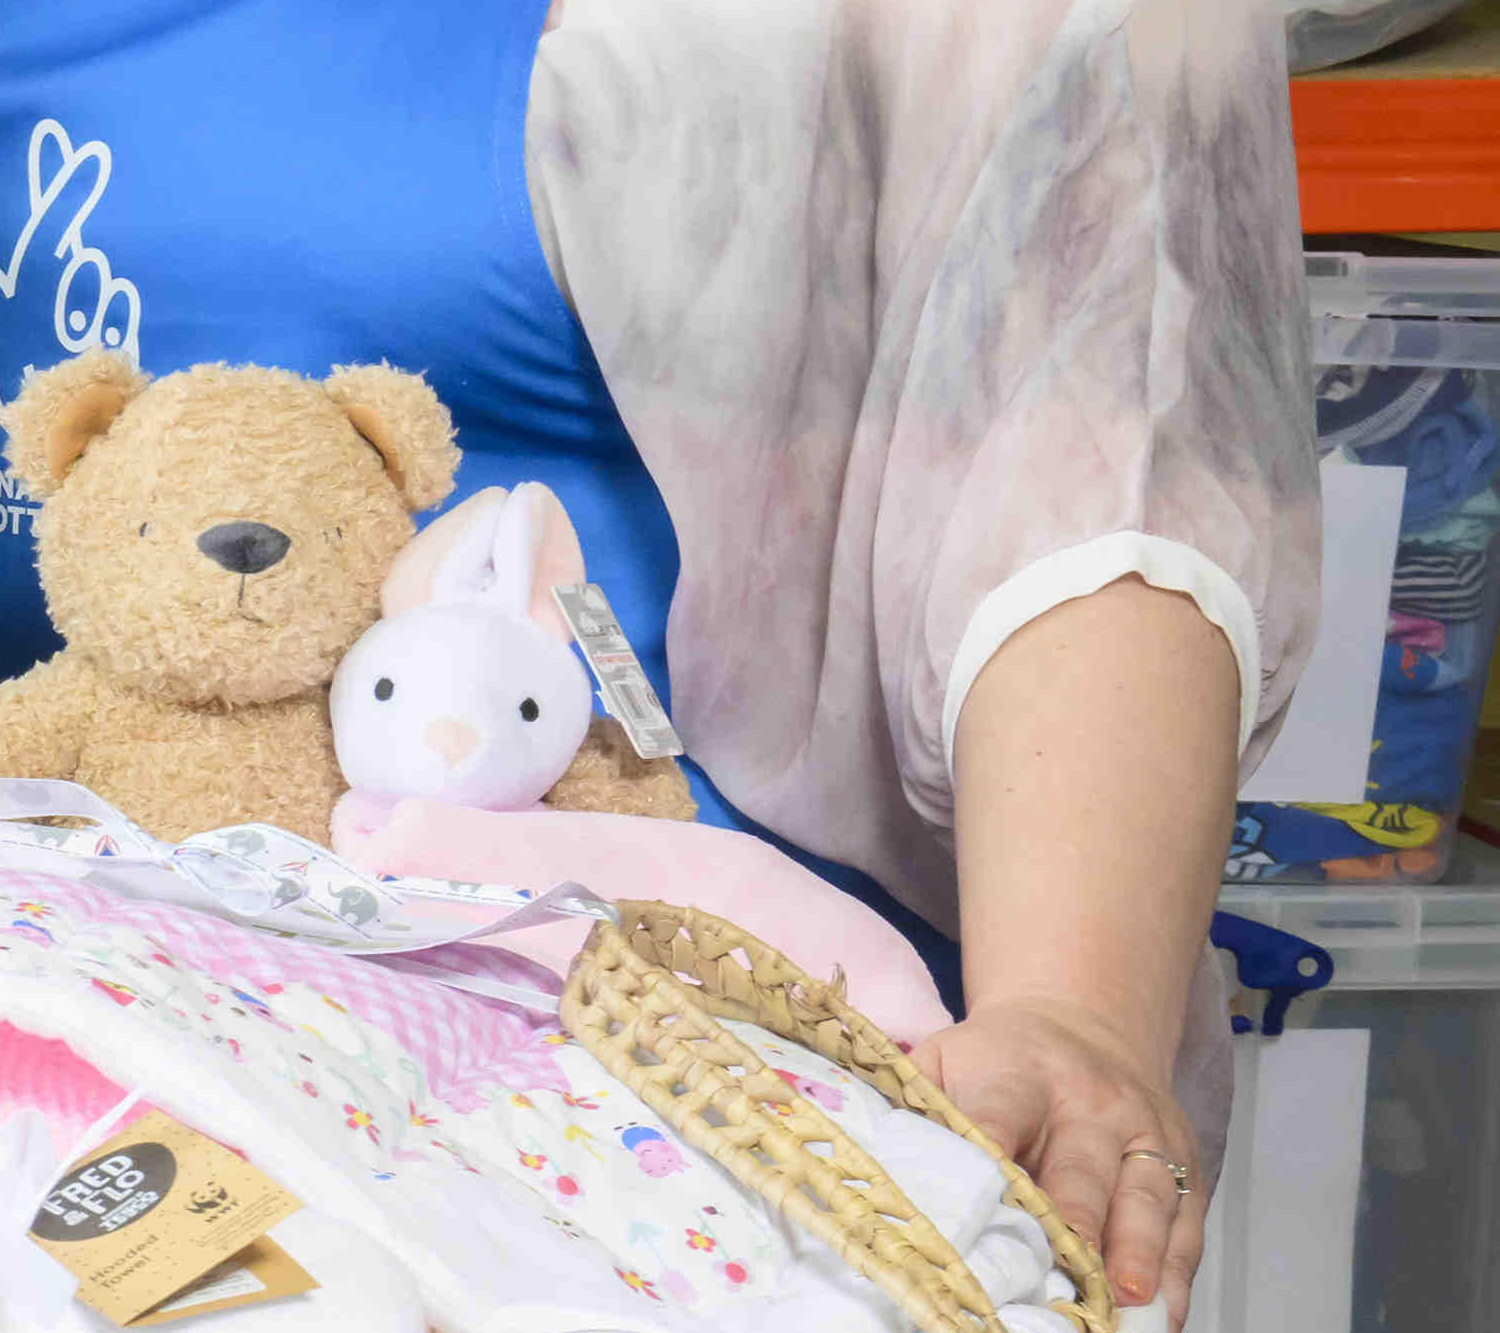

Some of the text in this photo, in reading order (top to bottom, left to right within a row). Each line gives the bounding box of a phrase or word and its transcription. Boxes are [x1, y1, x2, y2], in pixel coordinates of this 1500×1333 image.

[43, 1155, 134, 1215] FRED
[80, 1171, 146, 1214] FLO
[88, 1232, 159, 1283] Hooded
[100, 1254, 152, 1290] Towel
